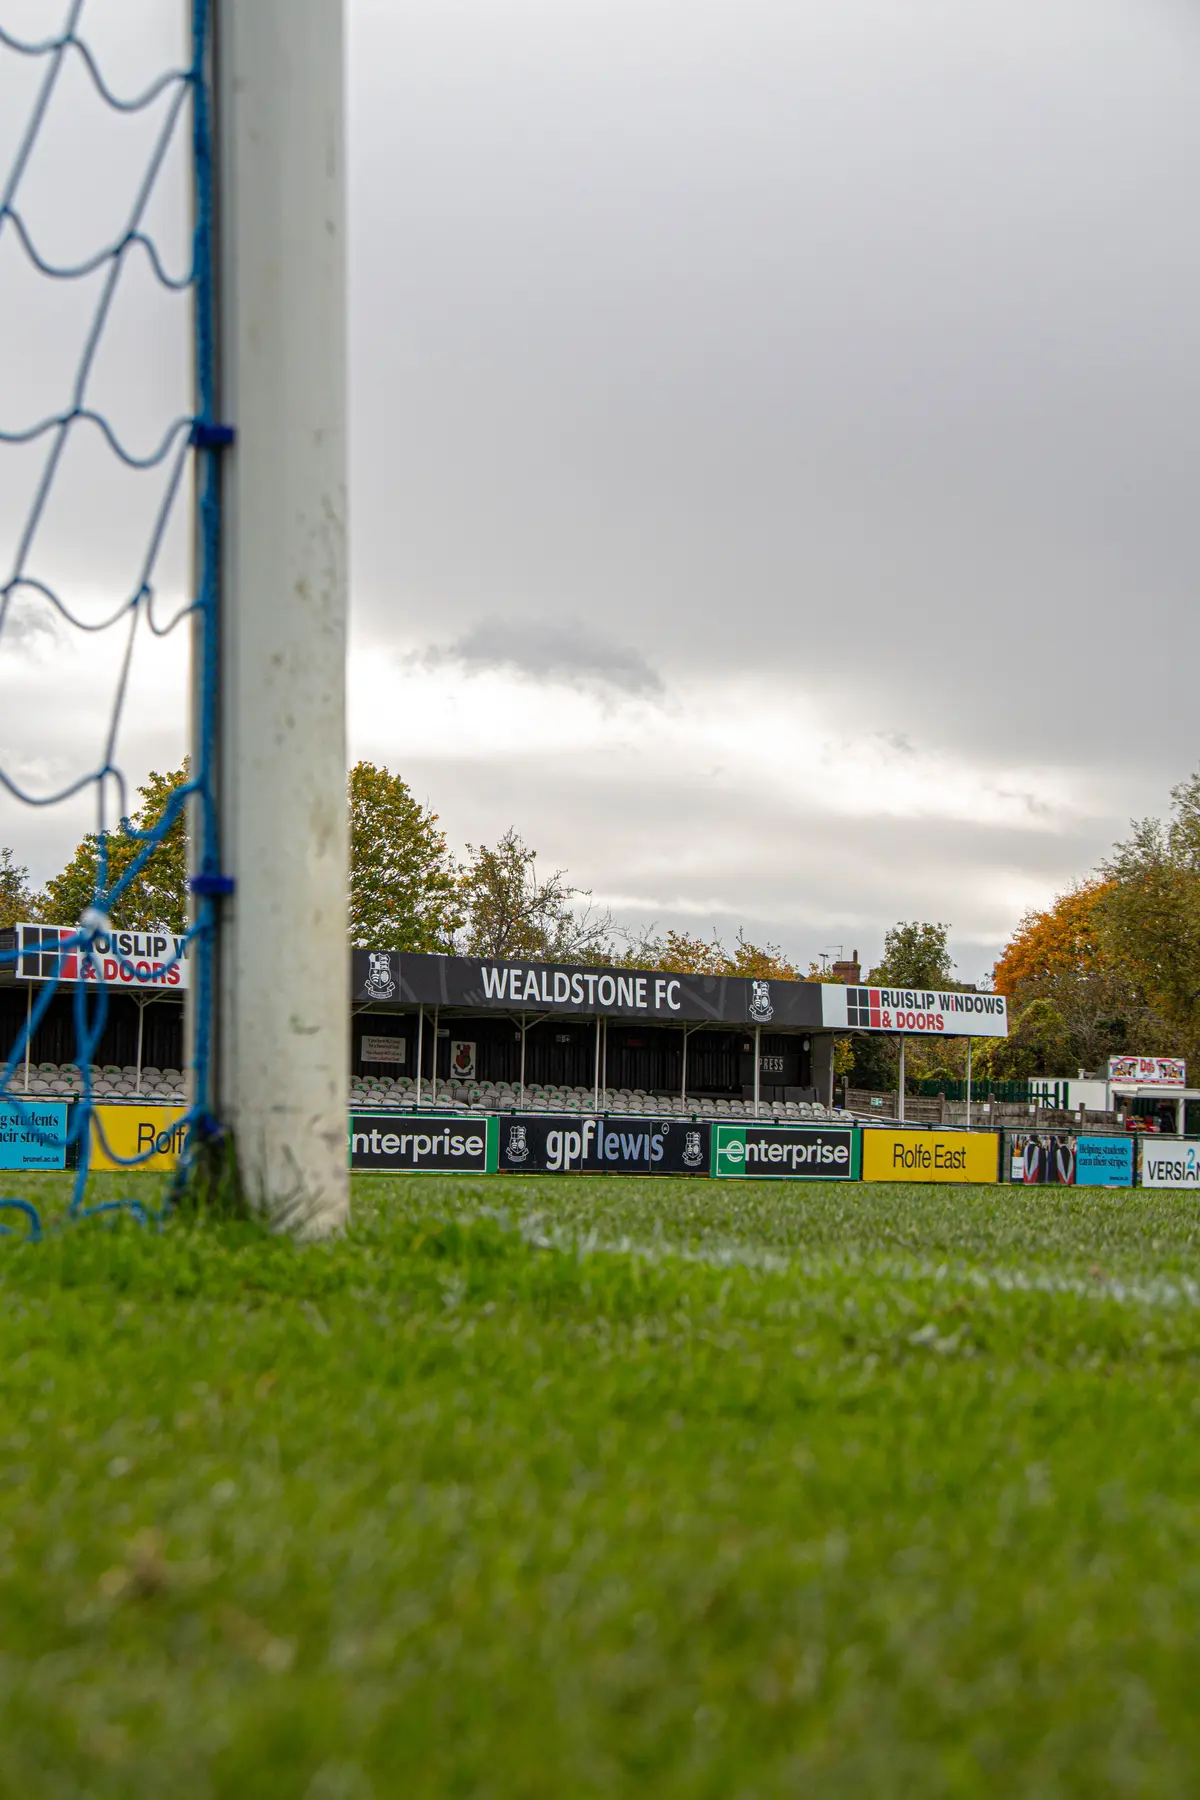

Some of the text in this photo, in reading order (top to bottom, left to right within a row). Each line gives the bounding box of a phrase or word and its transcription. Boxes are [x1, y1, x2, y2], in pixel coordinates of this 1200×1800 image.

[103, 958, 181, 985] DOORS
[481, 966, 681, 1010] WEALDSTONE FC
[881, 990, 936, 1010] RUISLIP
[882, 1010, 945, 1031] & DOORS
[10, 1111, 59, 1127] students
[20, 1128, 59, 1147] stripes
[137, 1123, 188, 1155] Rolf
[346, 1127, 484, 1163] nterprise
[726, 1138, 849, 1169] enterprise
[893, 1143, 966, 1169] Rolfe East
